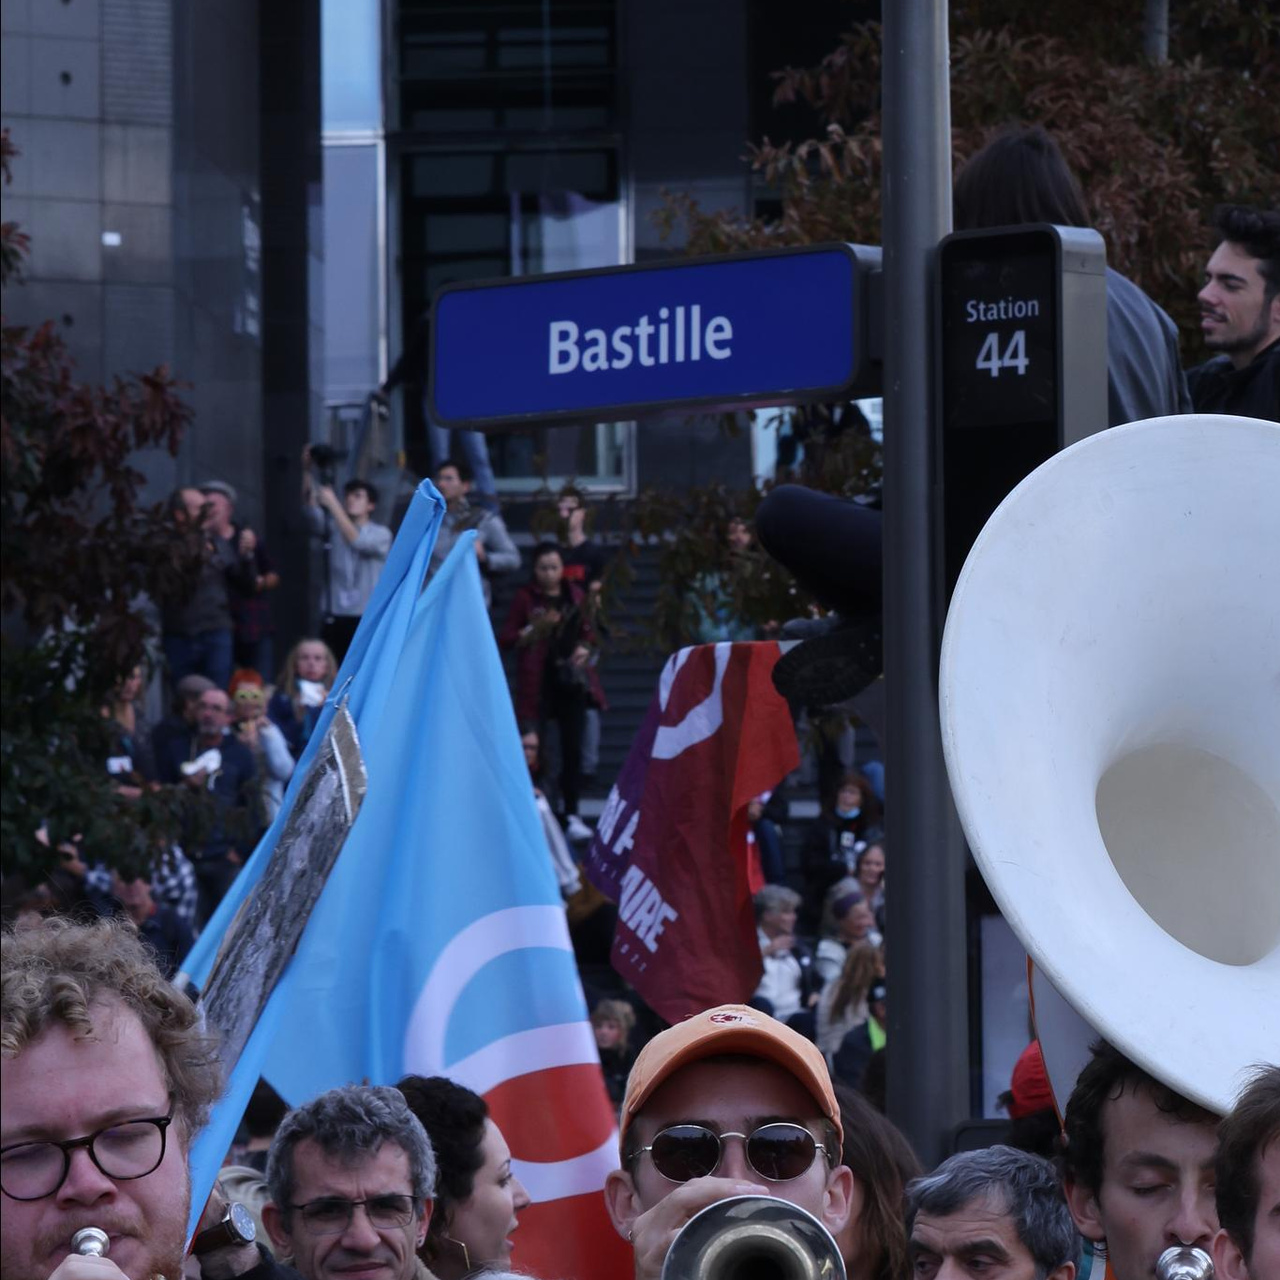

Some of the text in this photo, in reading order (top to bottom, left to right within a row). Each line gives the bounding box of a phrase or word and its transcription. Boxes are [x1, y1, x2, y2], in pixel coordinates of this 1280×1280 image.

[966, 296, 1039, 323] Station
[549, 304, 733, 375] Bastille
[976, 330, 1029, 377] 44
